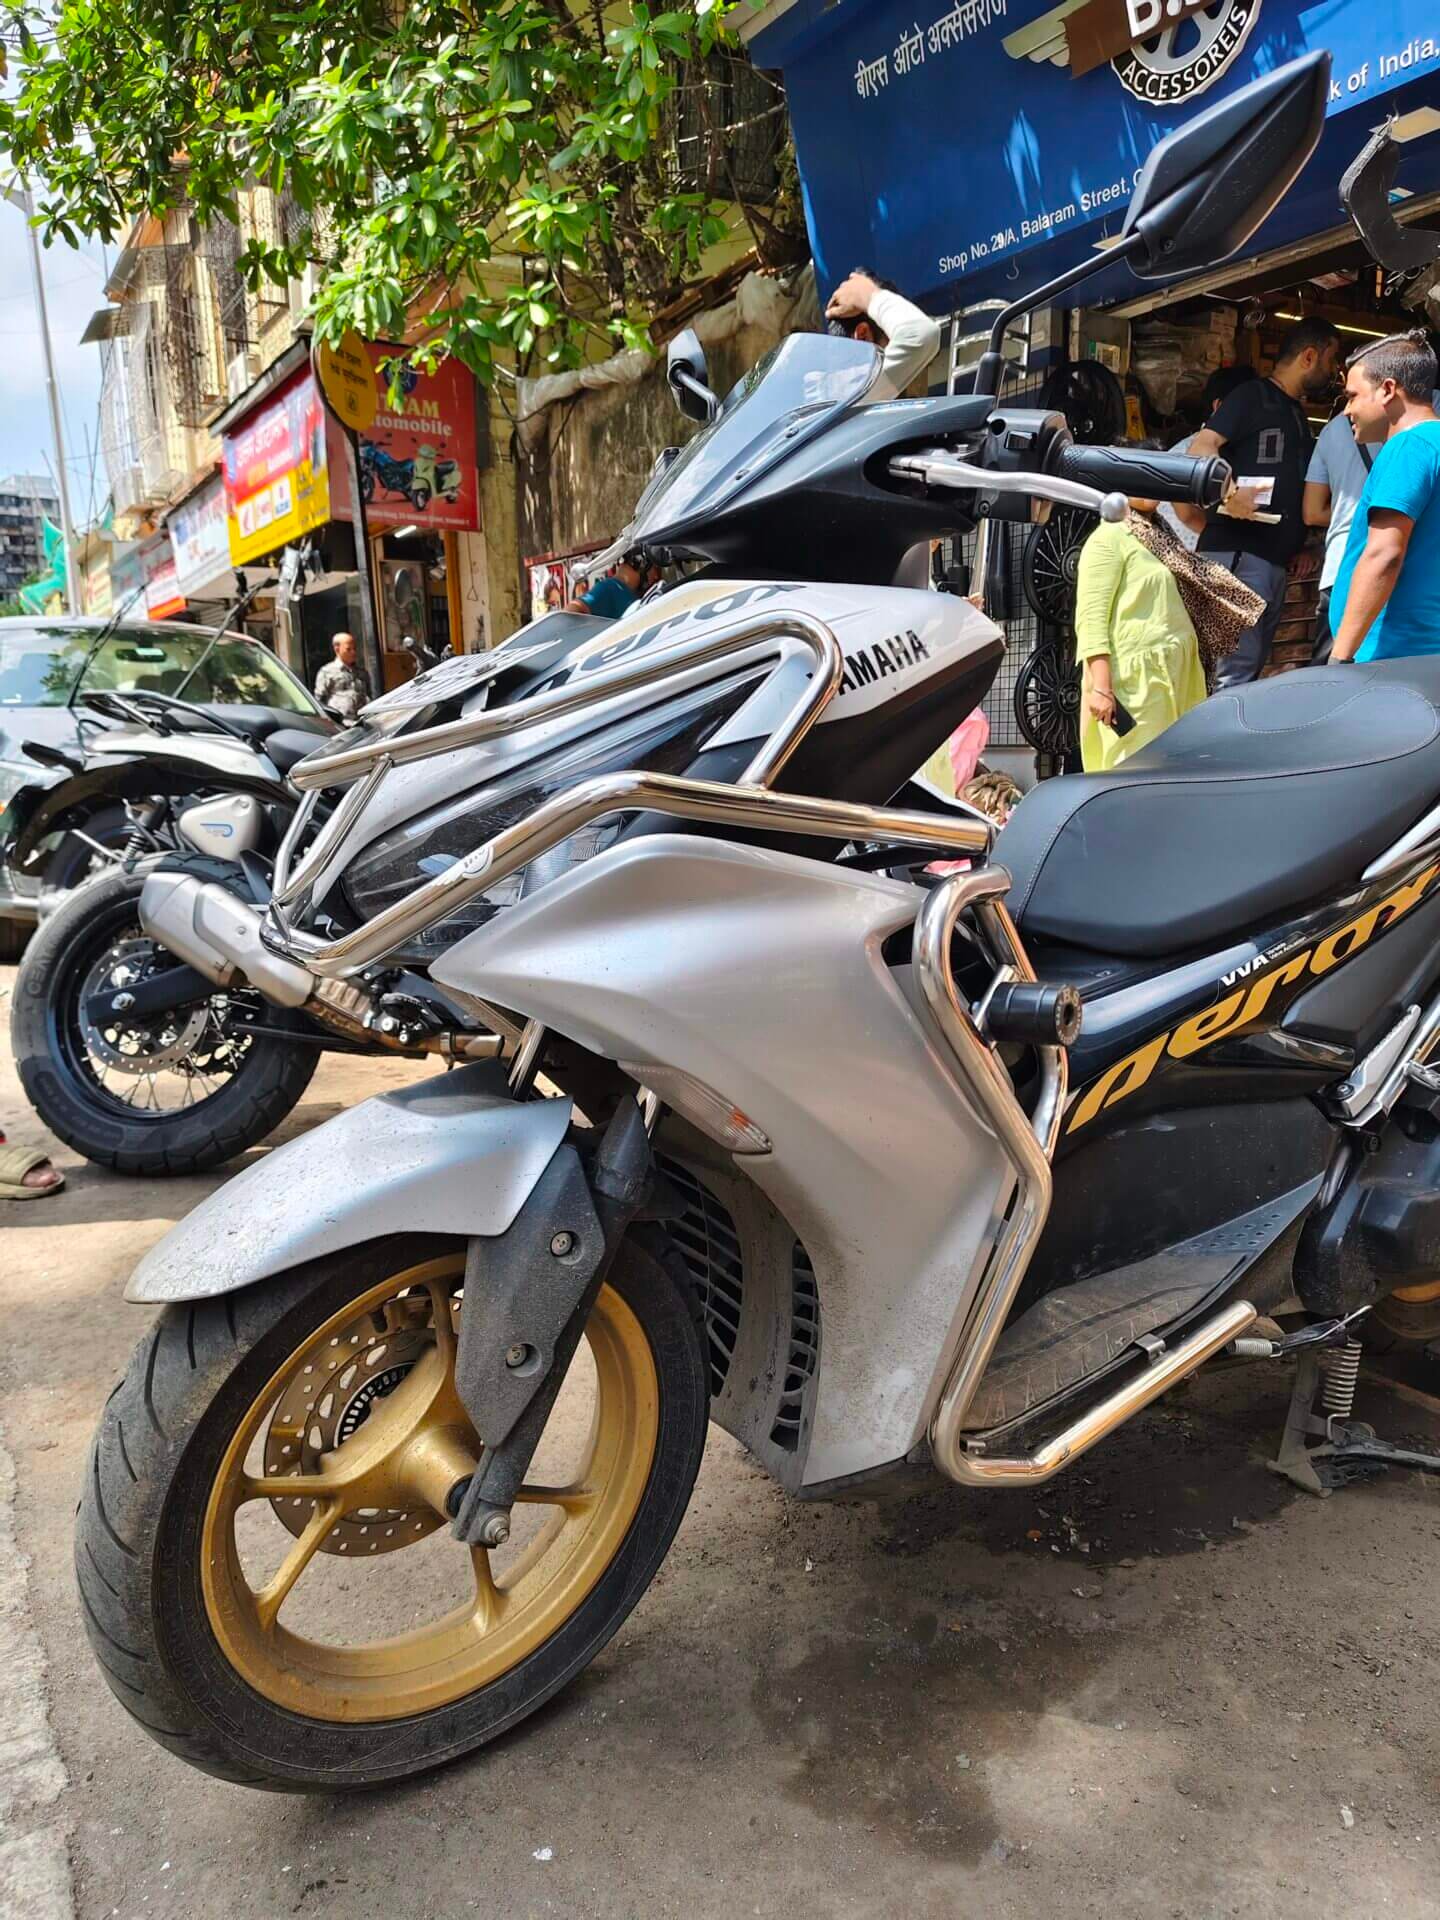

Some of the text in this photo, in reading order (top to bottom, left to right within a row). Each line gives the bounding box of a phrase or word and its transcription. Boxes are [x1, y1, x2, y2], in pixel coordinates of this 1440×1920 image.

[854, 59, 889, 99] बीएस
[893, 22, 925, 76] ऑटो
[1121, 6, 1248, 99] ACCESSOREIS
[1347, 61, 1369, 93] of
[1379, 38, 1440, 80] India,
[938, 251, 968, 274] Shop
[1021, 203, 1076, 239] Balaram
[1080, 175, 1131, 212] Street,
[371, 413, 453, 437] tomobile
[806, 629, 930, 696] AMAHA
[1220, 954, 1270, 987] VVA
